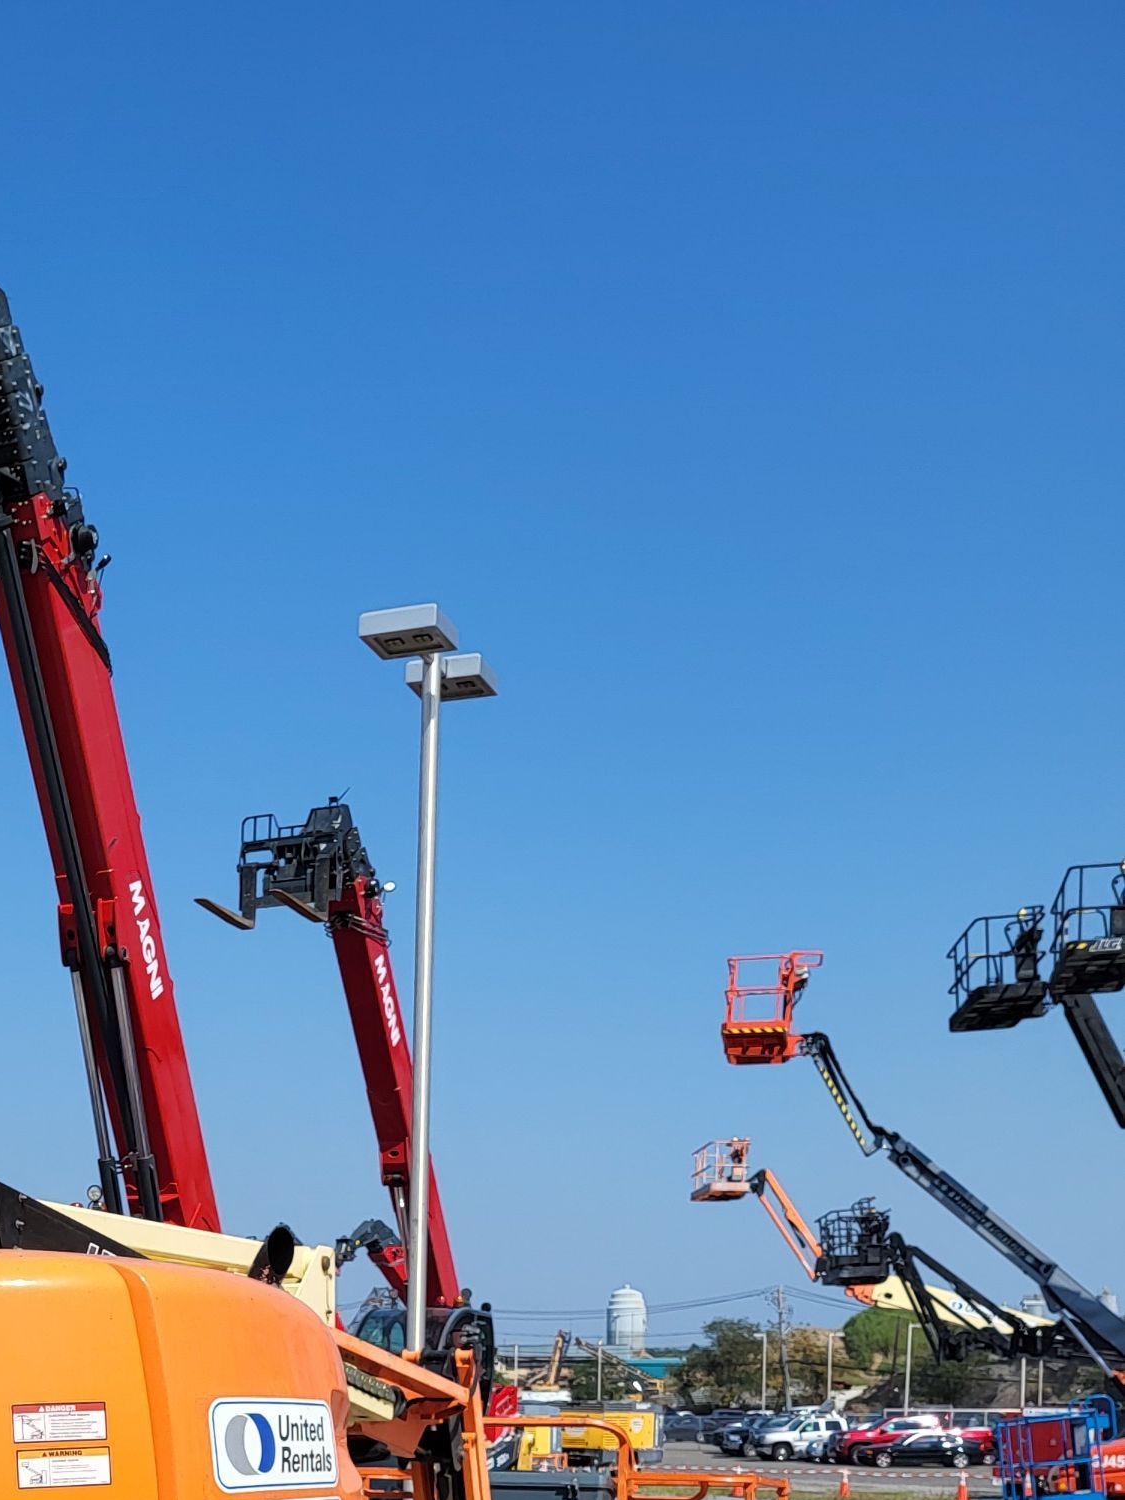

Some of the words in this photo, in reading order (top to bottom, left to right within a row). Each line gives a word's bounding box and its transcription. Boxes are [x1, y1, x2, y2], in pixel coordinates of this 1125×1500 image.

[129, 880, 164, 1001] MAGNI
[375, 954, 401, 1047] MAGNI
[278, 1414, 325, 1442] United
[48, 1450, 83, 1458] WARNING
[281, 1446, 332, 1473] Rentals
